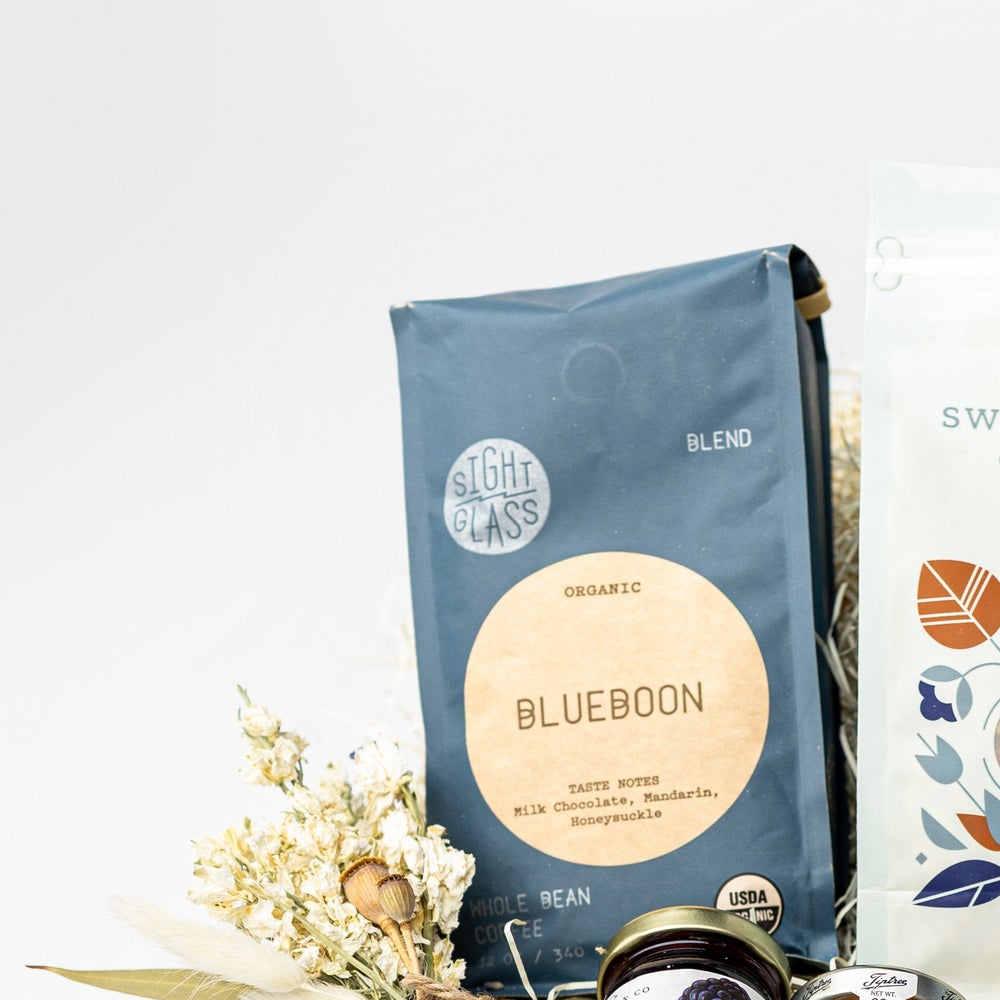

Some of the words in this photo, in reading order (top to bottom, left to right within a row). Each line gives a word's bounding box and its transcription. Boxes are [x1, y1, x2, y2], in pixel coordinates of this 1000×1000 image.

[686, 428, 753, 453] BLEND
[453, 446, 533, 497] SIGHT
[453, 498, 540, 548] GLASS
[563, 581, 642, 598] ORGANIC
[516, 681, 705, 731] BLUEBOON
[568, 780, 610, 794] TASTE
[617, 775, 660, 790] NOTES
[514, 804, 547, 817] Milk
[553, 797, 635, 813] Chocolate,
[643, 787, 719, 804] Mandarin,
[570, 808, 662, 827] Honeysuckle
[469, 893, 529, 918] WHOLE
[540, 886, 591, 910] BEAN
[729, 889, 768, 906] USDA
[861, 973, 908, 990] Tiptree
